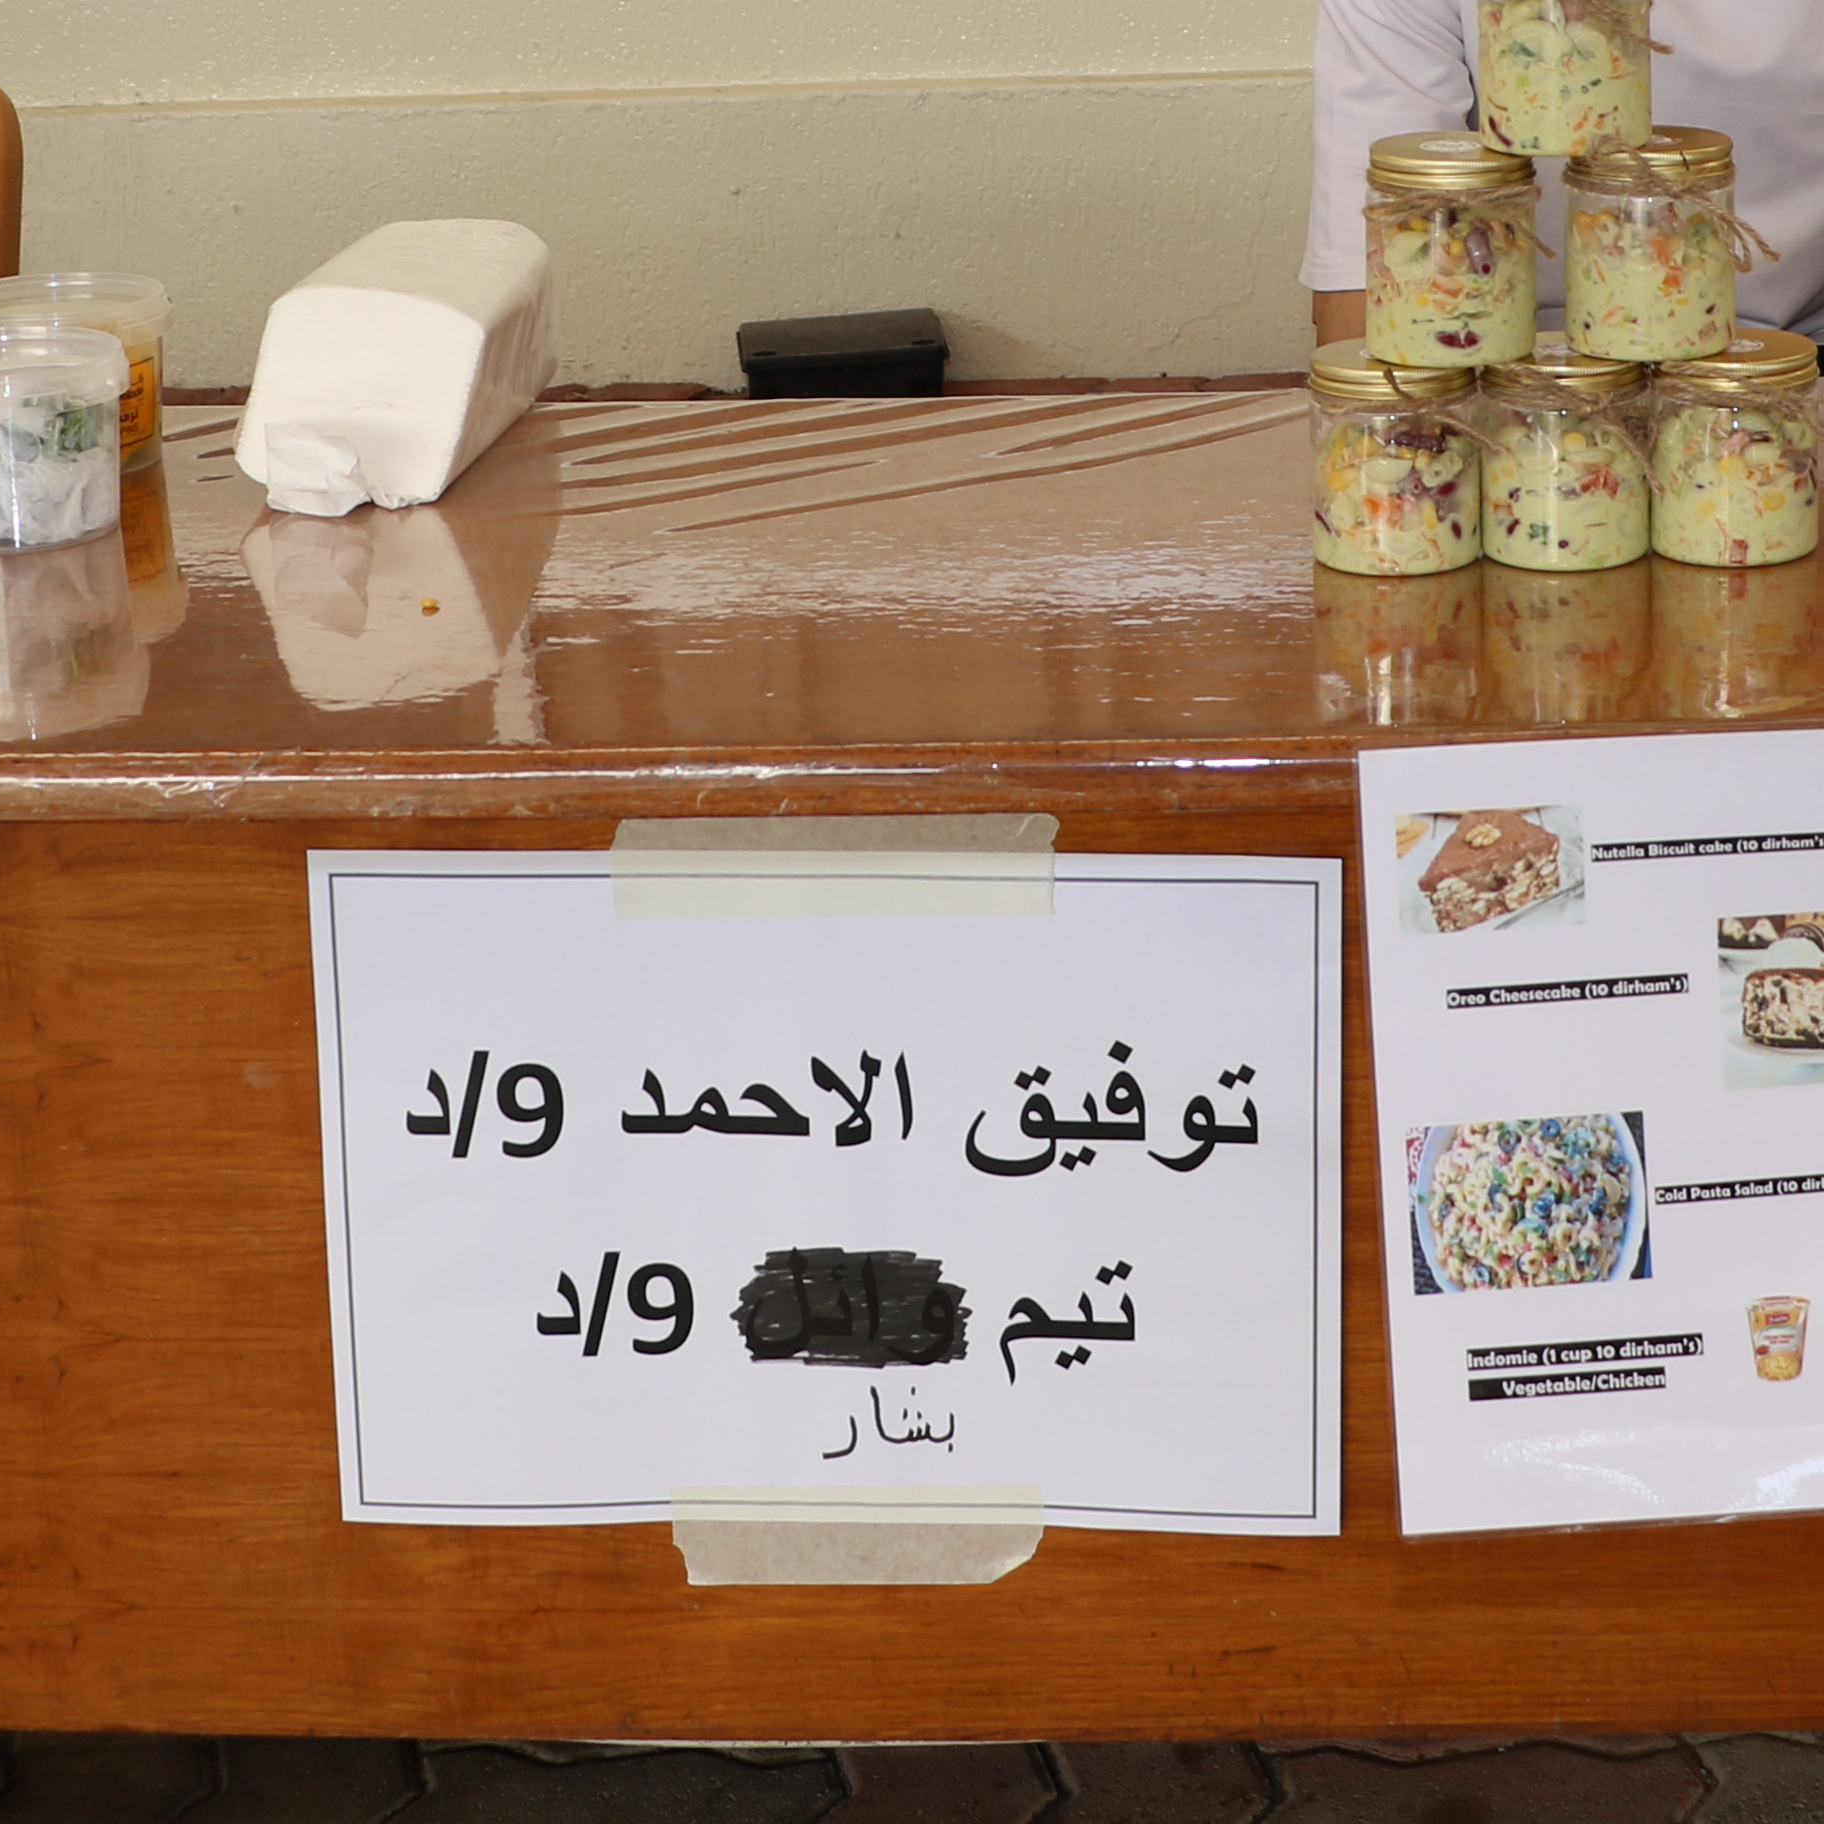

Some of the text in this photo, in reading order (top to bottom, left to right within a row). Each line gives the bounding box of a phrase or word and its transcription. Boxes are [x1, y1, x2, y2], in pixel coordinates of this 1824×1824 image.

[1591, 844, 1645, 860] Nutella
[1648, 841, 1696, 858] Biscuit
[1698, 839, 1733, 855] cake
[1736, 838, 1758, 854] (10
[1447, 976, 1688, 1006] Oreo Cheesecake (10 dirham's)
[619, 1048, 917, 1149] الاحمد
[963, 1041, 1260, 1176] توفيق
[1656, 1187, 1687, 1203] Cold
[1691, 1184, 1731, 1200] Pasta
[1734, 1180, 1773, 1197] Salad
[1777, 1179, 1798, 1196] (10
[996, 1258, 1138, 1385] تيم
[1467, 1336, 1704, 1369] Indomie (1 cup 10 dirham's)
[1502, 1370, 1666, 1397] Vegetable/Chicken
